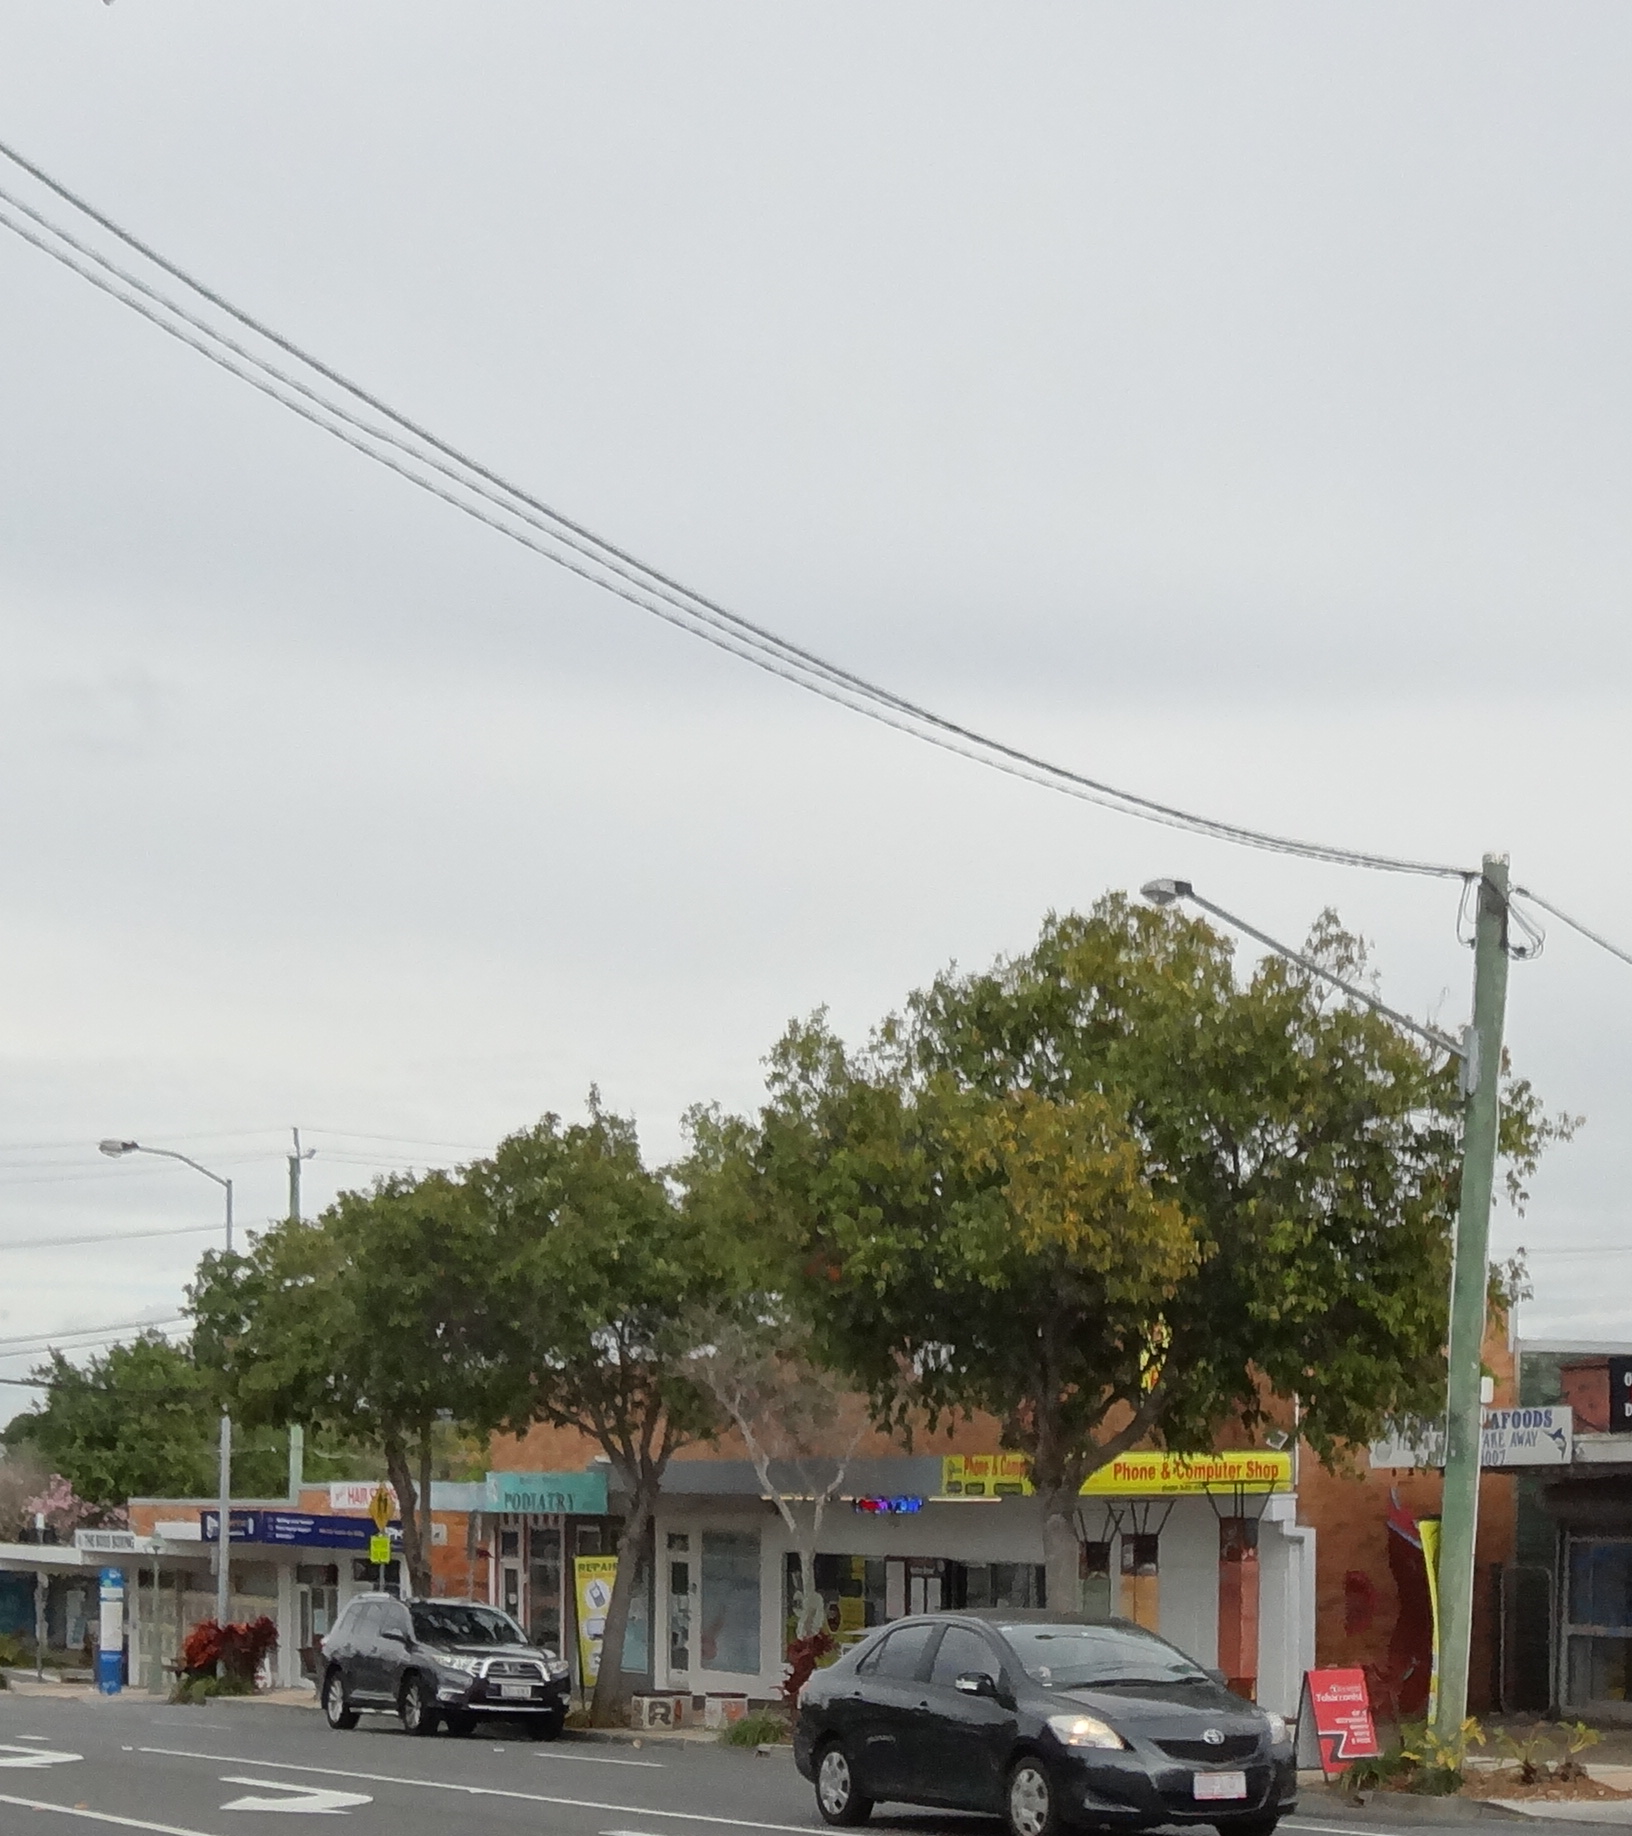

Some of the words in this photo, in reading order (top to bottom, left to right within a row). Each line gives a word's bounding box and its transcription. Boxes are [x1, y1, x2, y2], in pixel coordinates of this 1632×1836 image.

[1482, 1409, 1553, 1430] AFOODS
[1483, 1431, 1505, 1448] AKE
[1510, 1430, 1538, 1447] AWAY
[1113, 1463, 1155, 1481] Phone
[1161, 1462, 1171, 1481] &
[1176, 1461, 1242, 1480] Computer
[1246, 1460, 1279, 1479] Shop
[504, 1491, 575, 1511] PODIATRY
